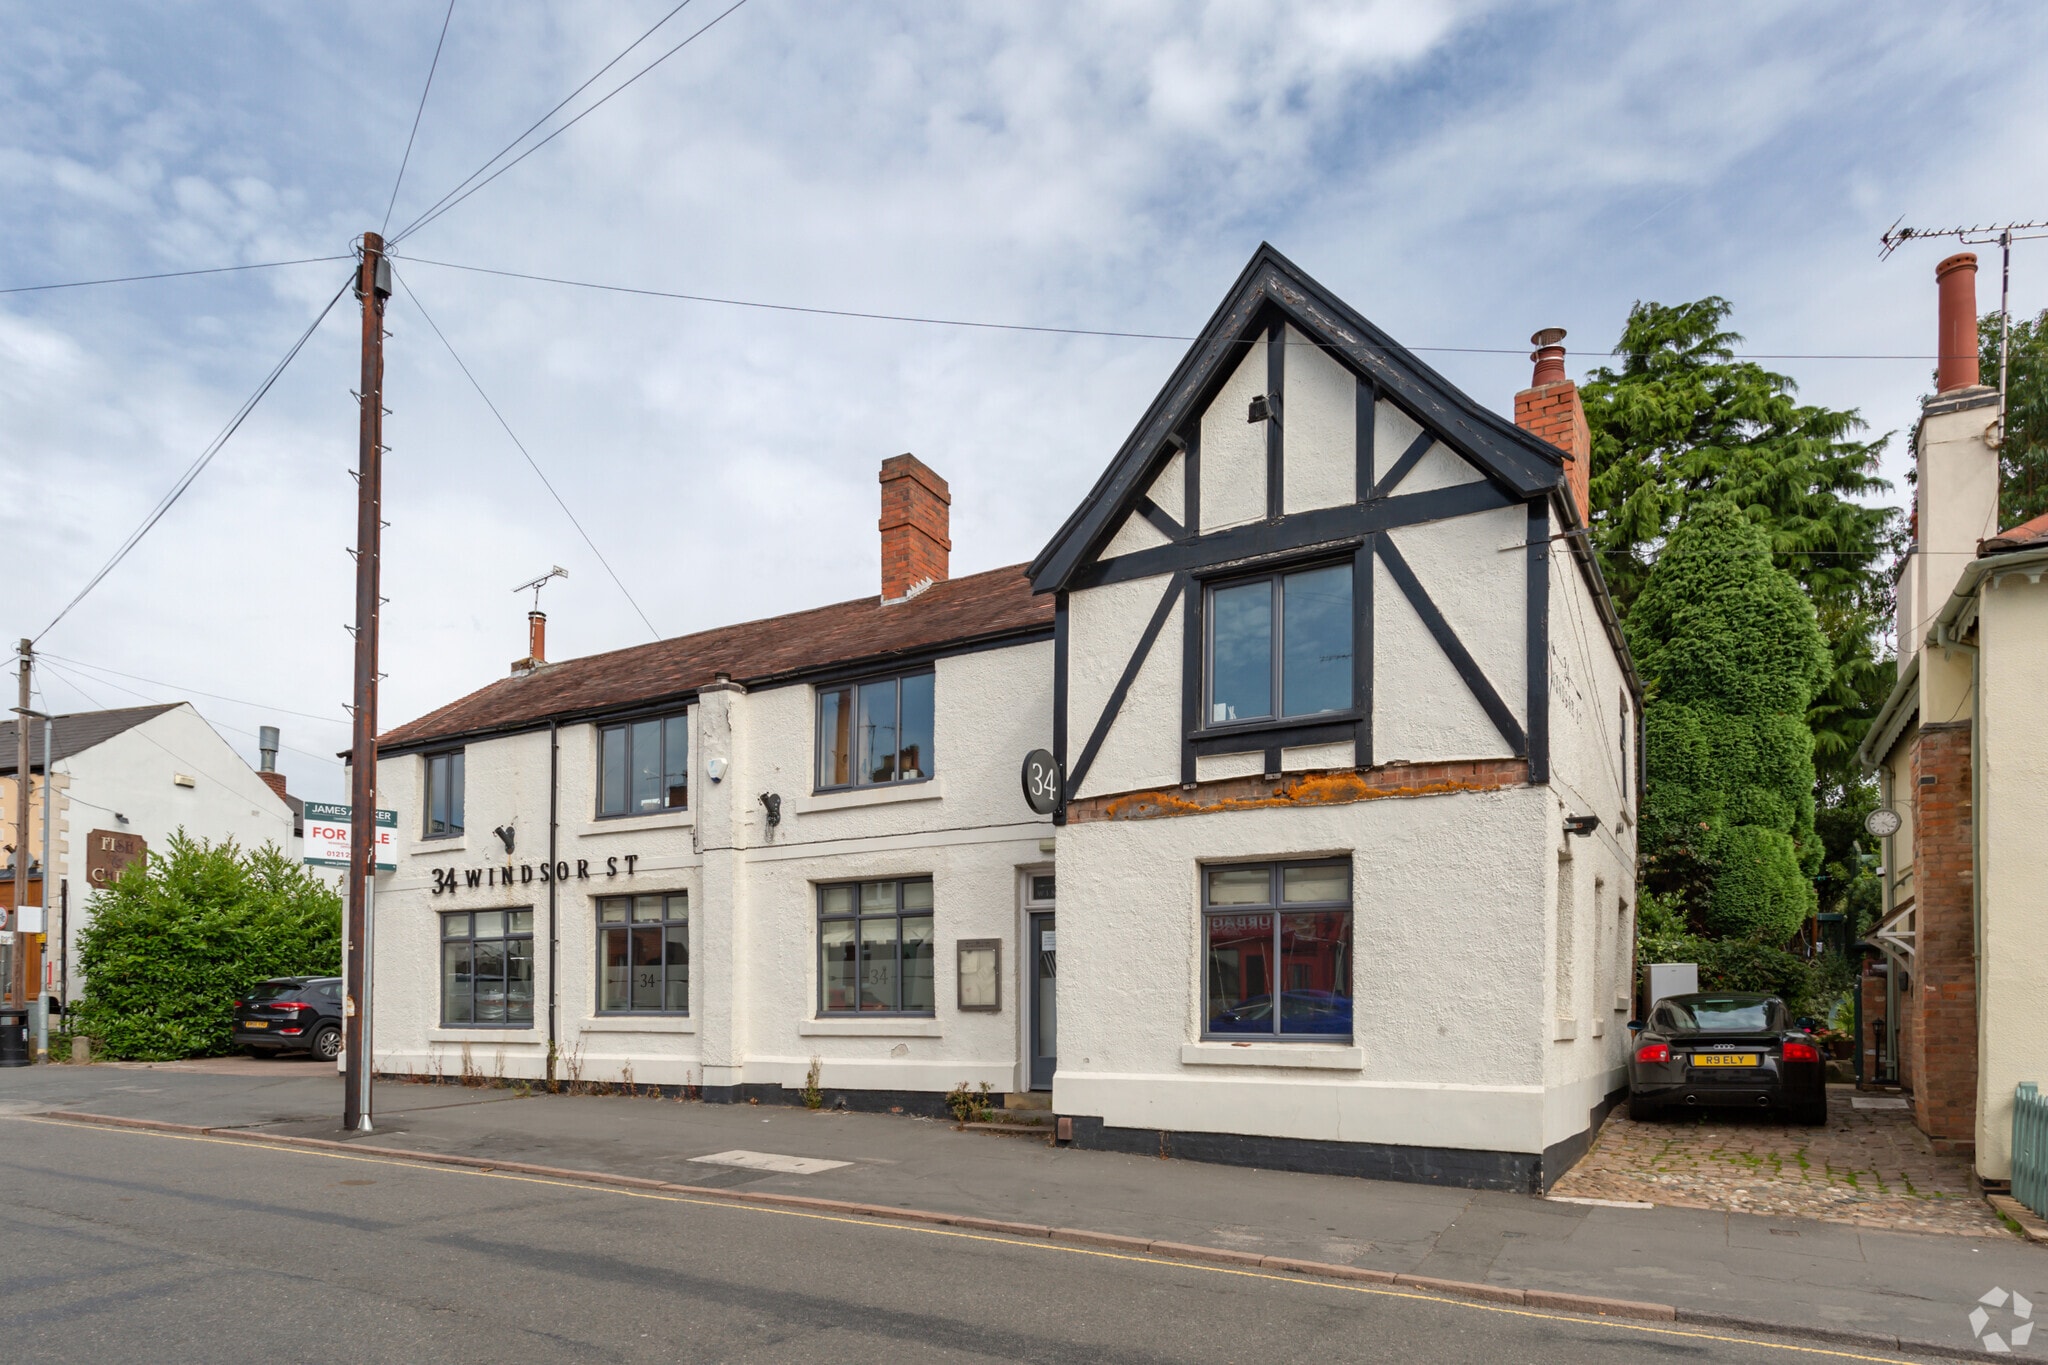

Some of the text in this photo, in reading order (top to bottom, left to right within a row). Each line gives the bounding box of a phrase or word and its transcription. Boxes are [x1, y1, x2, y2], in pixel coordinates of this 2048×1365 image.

[1032, 763, 1056, 800] 34
[312, 805, 346, 815] JAMES
[313, 827, 346, 840] FOR
[432, 854, 639, 895] 34 WINDSOR ST
[639, 973, 655, 988] 34
[870, 969, 888, 985] 34
[1706, 1056, 1745, 1064] R9 ELY
